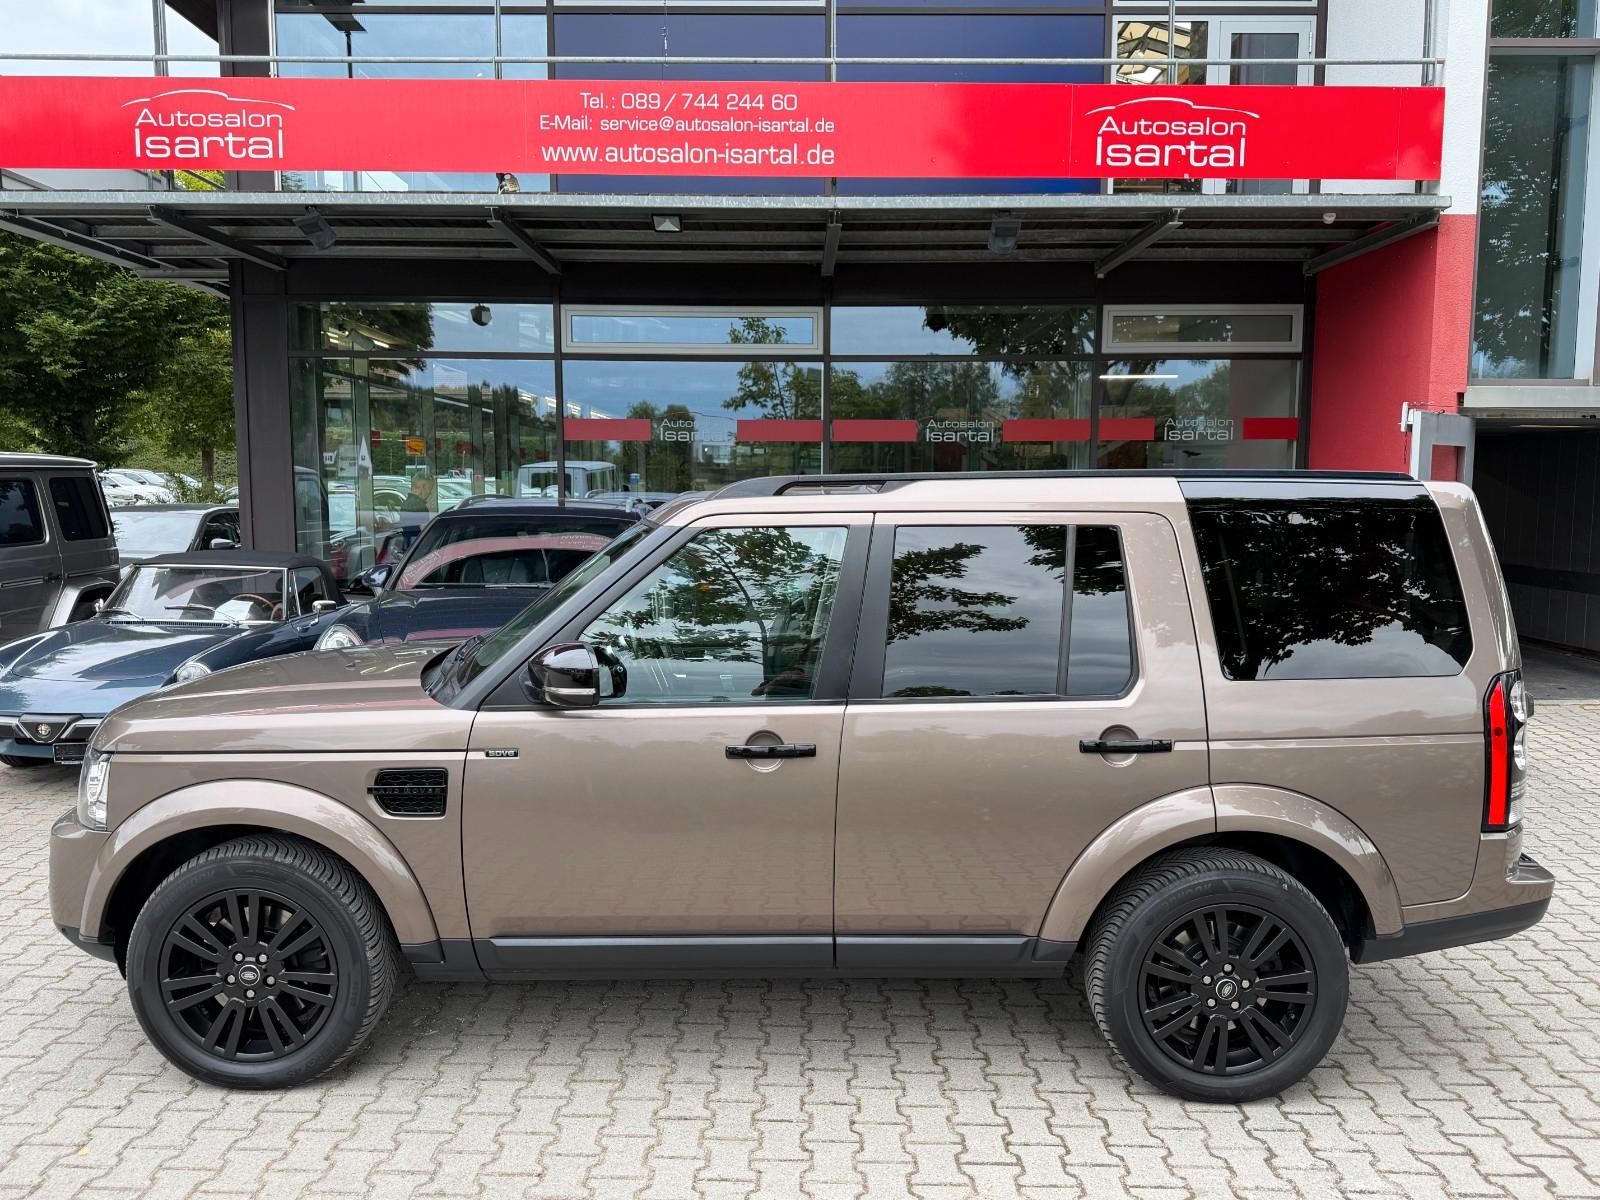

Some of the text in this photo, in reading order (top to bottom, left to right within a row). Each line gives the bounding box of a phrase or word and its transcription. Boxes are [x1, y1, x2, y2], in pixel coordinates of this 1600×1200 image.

[579, 92, 615, 109] Tel.:
[621, 92, 661, 110] 089
[681, 93, 720, 110] 744
[726, 93, 765, 111] 244
[771, 93, 798, 111] 60
[135, 108, 283, 128] Autosalon
[539, 114, 835, 133] E-Mail: service@autosalon-isartal.de
[1098, 116, 1246, 136] Autosalon
[134, 128, 284, 159] Isartal
[1096, 136, 1246, 167] Isartal
[541, 142, 835, 165] www.autosalon-isartal.de
[927, 419, 994, 429] Autosalon
[1164, 426, 1234, 441] Isartal
[926, 428, 994, 442] Isartal
